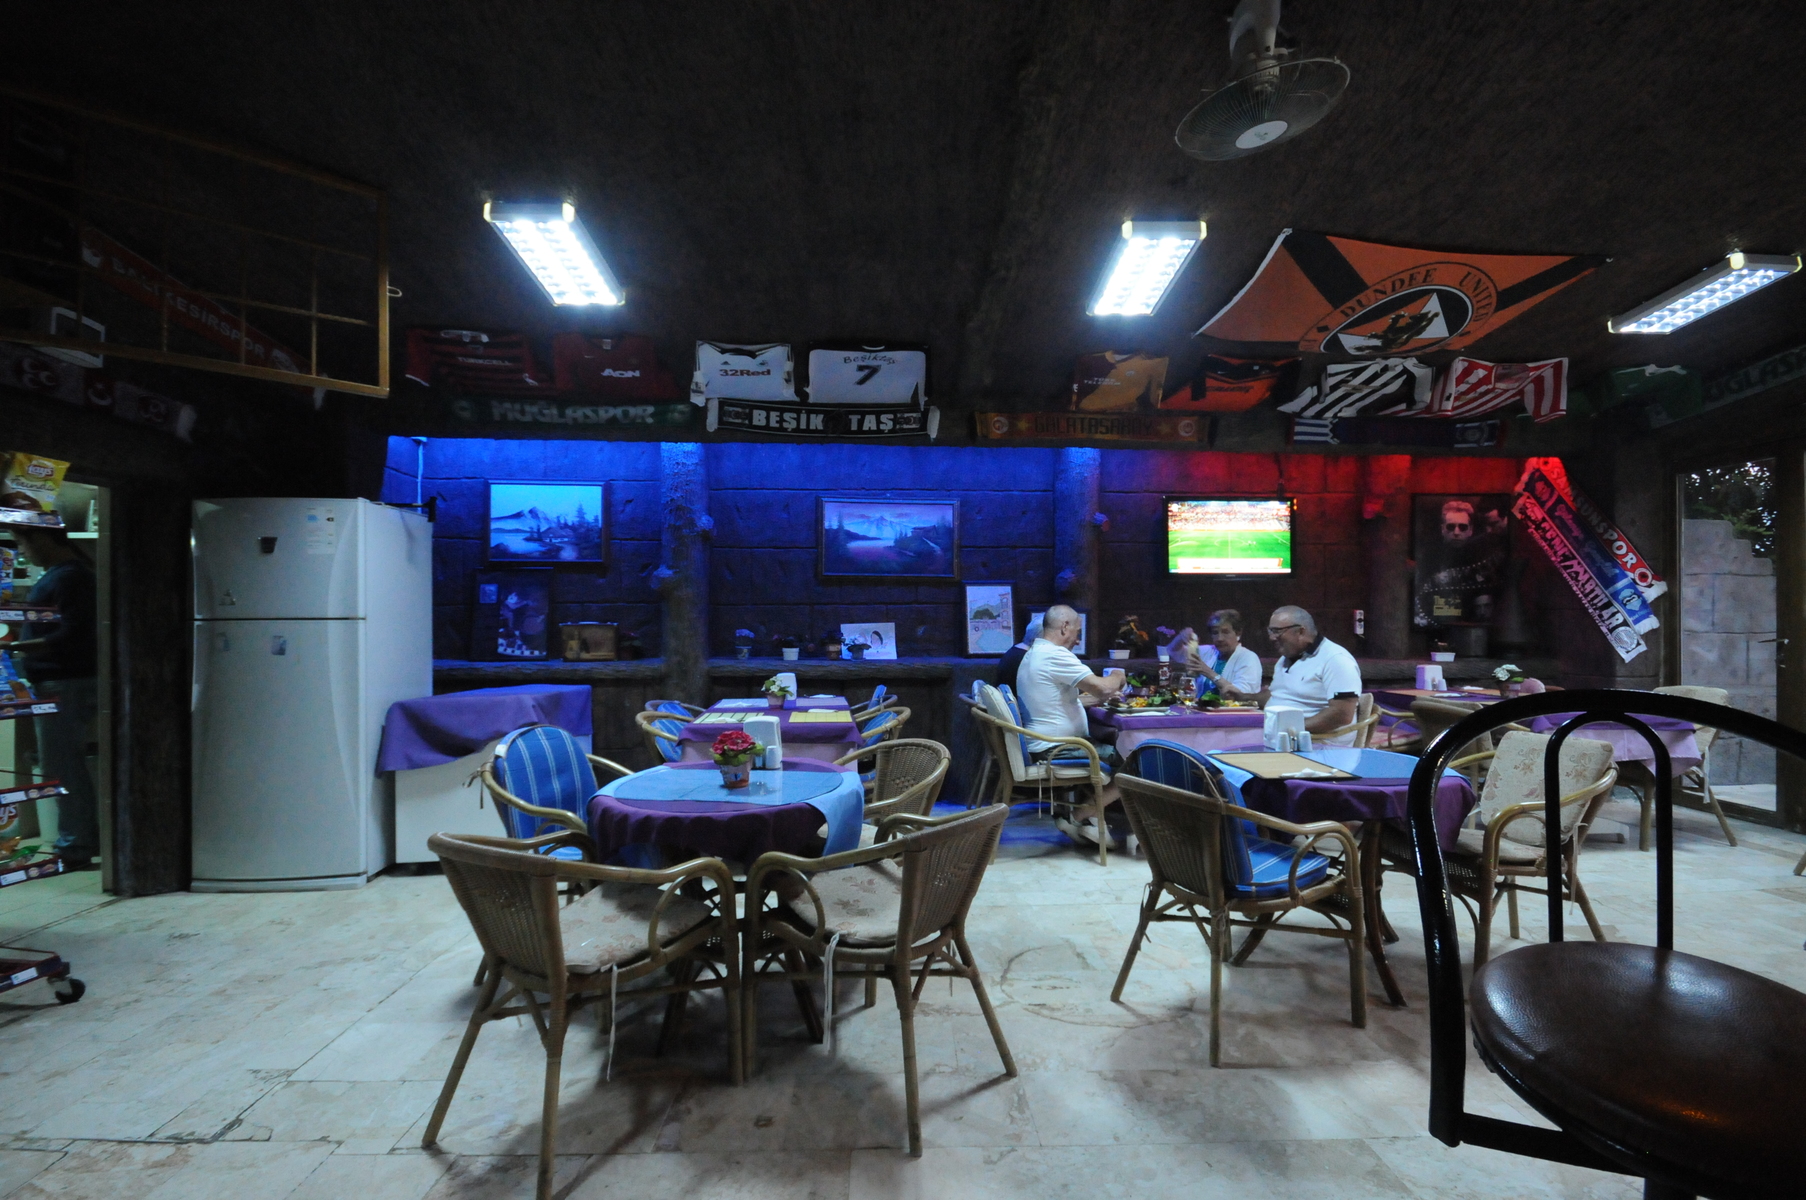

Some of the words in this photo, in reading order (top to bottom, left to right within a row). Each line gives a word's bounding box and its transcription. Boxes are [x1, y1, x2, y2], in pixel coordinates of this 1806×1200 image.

[1340, 267, 1437, 317] DUNDEE
[1458, 270, 1494, 323] UNITED
[719, 368, 772, 378] 32Red
[855, 364, 882, 386] 7
[848, 413, 894, 433] TAŞ
[1550, 467, 1638, 569] SAMSUNSPOR
